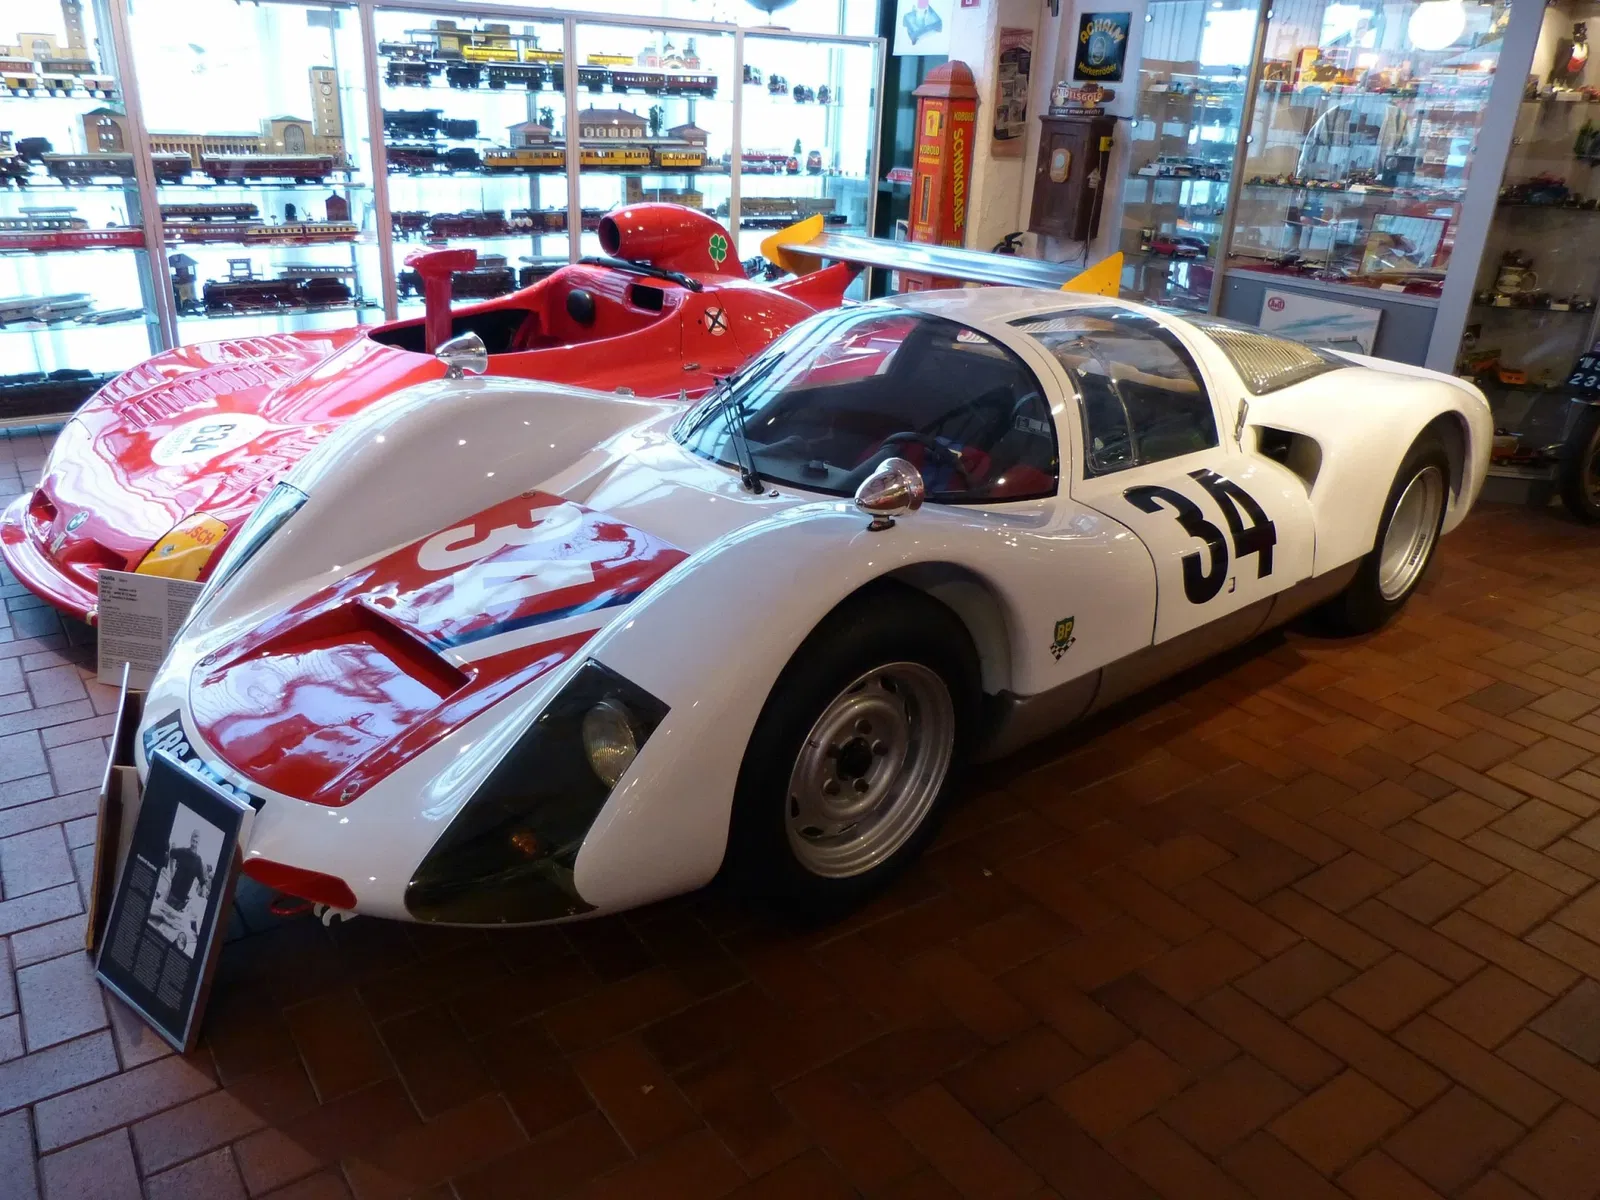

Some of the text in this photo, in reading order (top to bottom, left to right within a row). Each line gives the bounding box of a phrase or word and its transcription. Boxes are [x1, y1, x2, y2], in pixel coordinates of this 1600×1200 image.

[1081, 18, 1125, 44] ACHALM
[954, 111, 976, 122] KOBOLD
[919, 144, 940, 156] KOBOLD
[953, 127, 964, 232] SCHOKOLADE
[1569, 373, 1600, 390] 23
[182, 423, 238, 454] 634
[1123, 468, 1277, 604] 34
[1057, 621, 1073, 641] BP
